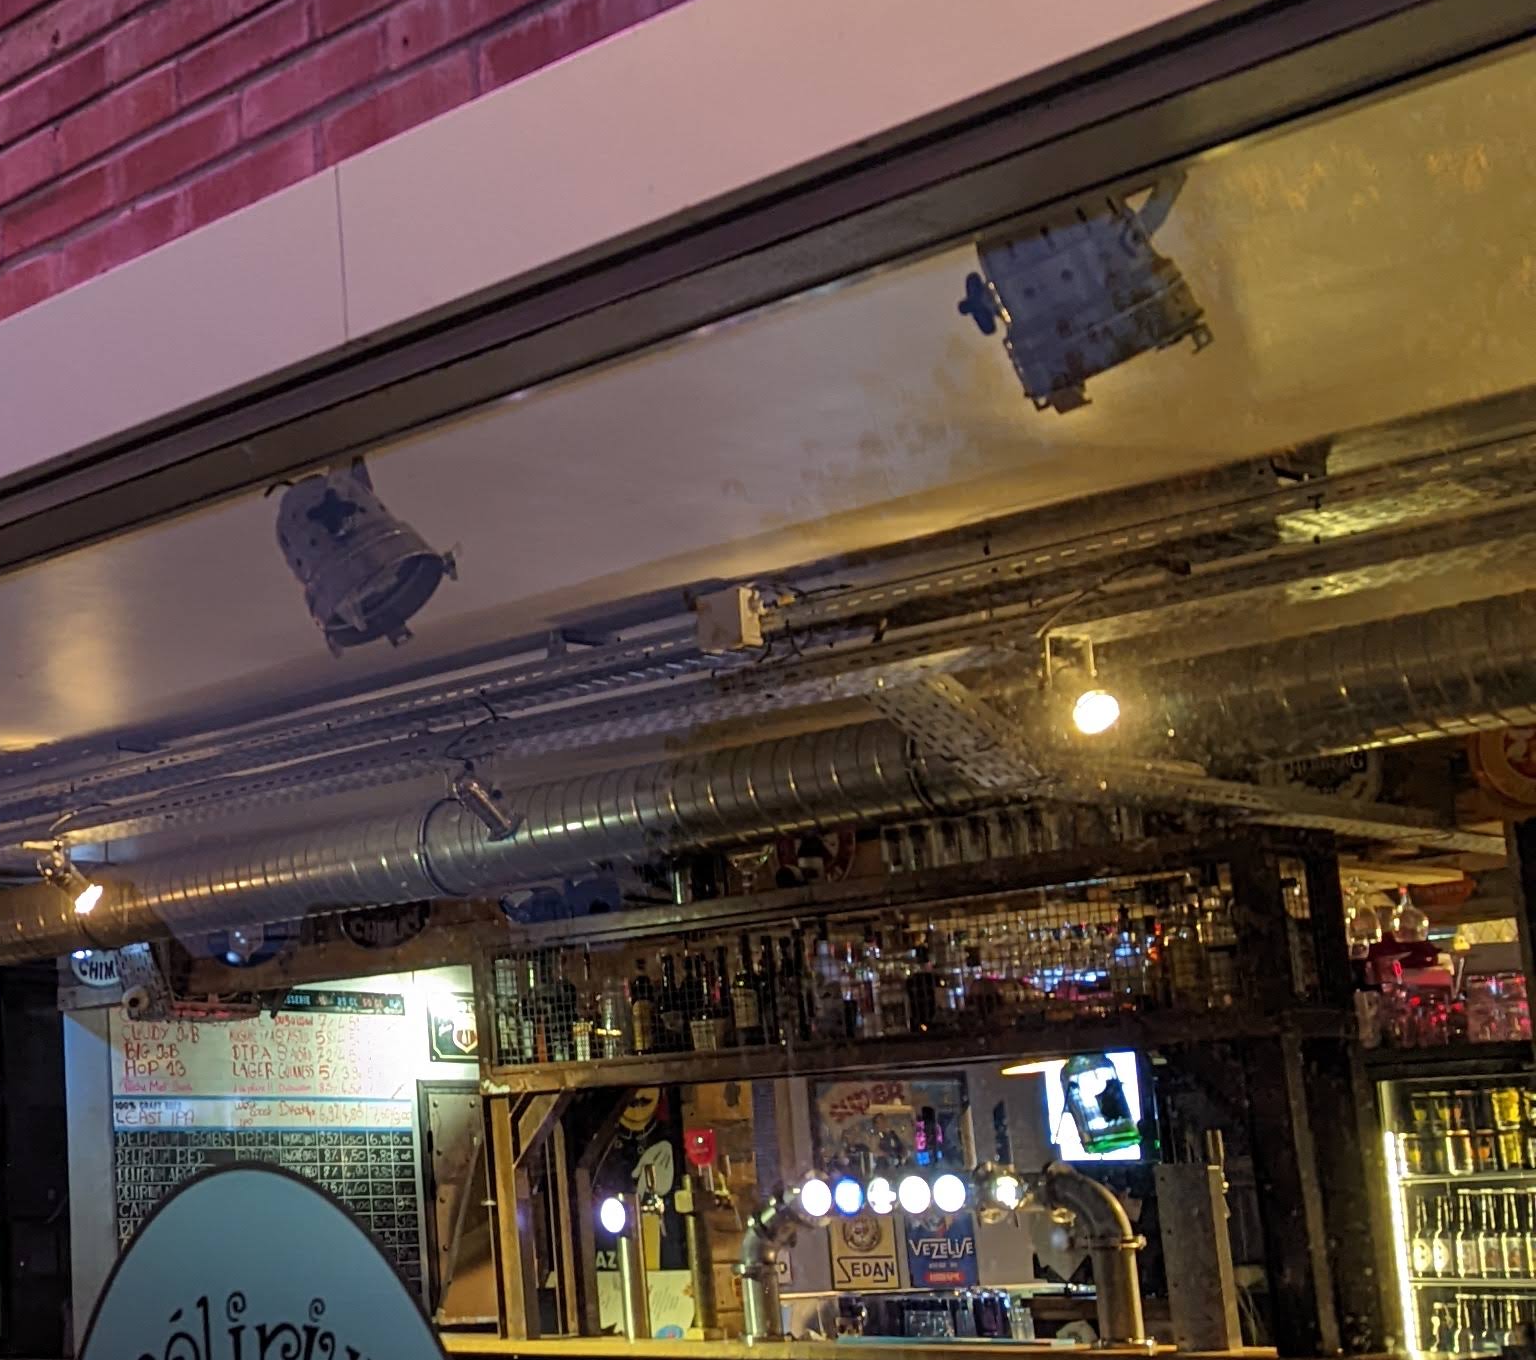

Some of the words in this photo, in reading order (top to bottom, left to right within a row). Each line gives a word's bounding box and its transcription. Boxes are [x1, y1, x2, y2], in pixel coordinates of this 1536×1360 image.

[78, 960, 116, 982] CHIM
[232, 1061, 276, 1079] LAGER
[836, 1255, 896, 1284] SEDAN
